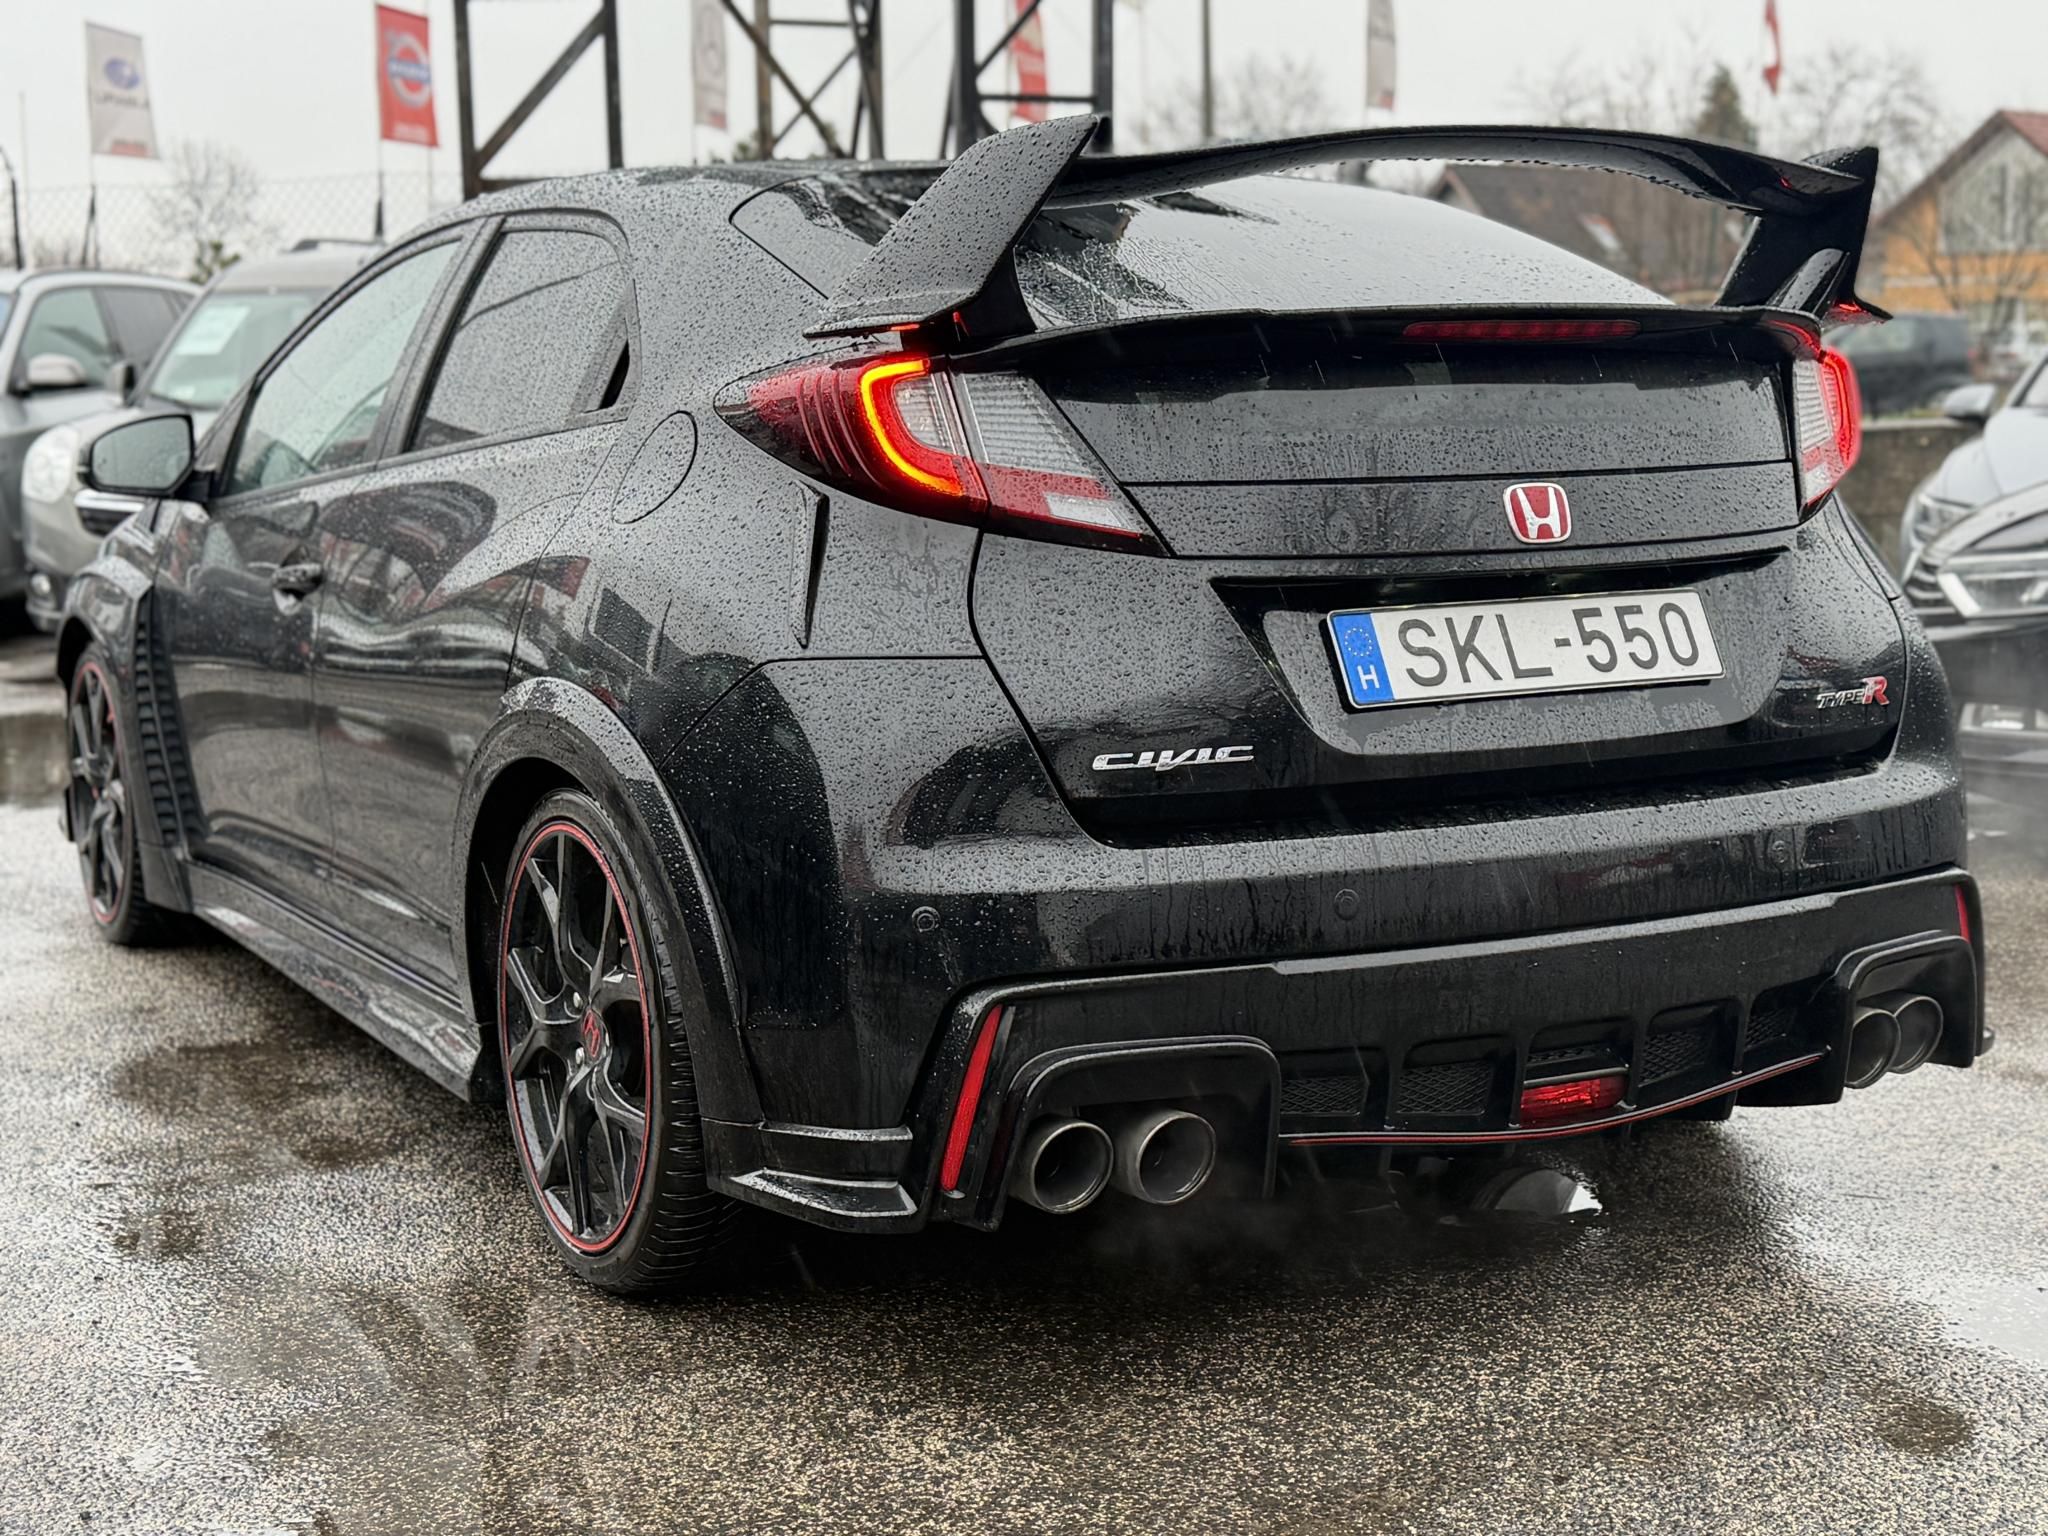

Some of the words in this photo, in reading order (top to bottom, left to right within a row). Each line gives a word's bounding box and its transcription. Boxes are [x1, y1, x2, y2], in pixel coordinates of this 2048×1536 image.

[1397, 602, 1700, 687] SKL-550
[1356, 664, 1380, 690] H
[1816, 688, 1865, 709] TYPE
[1861, 675, 1890, 706] R
[1092, 745, 1254, 772] CIVIC
